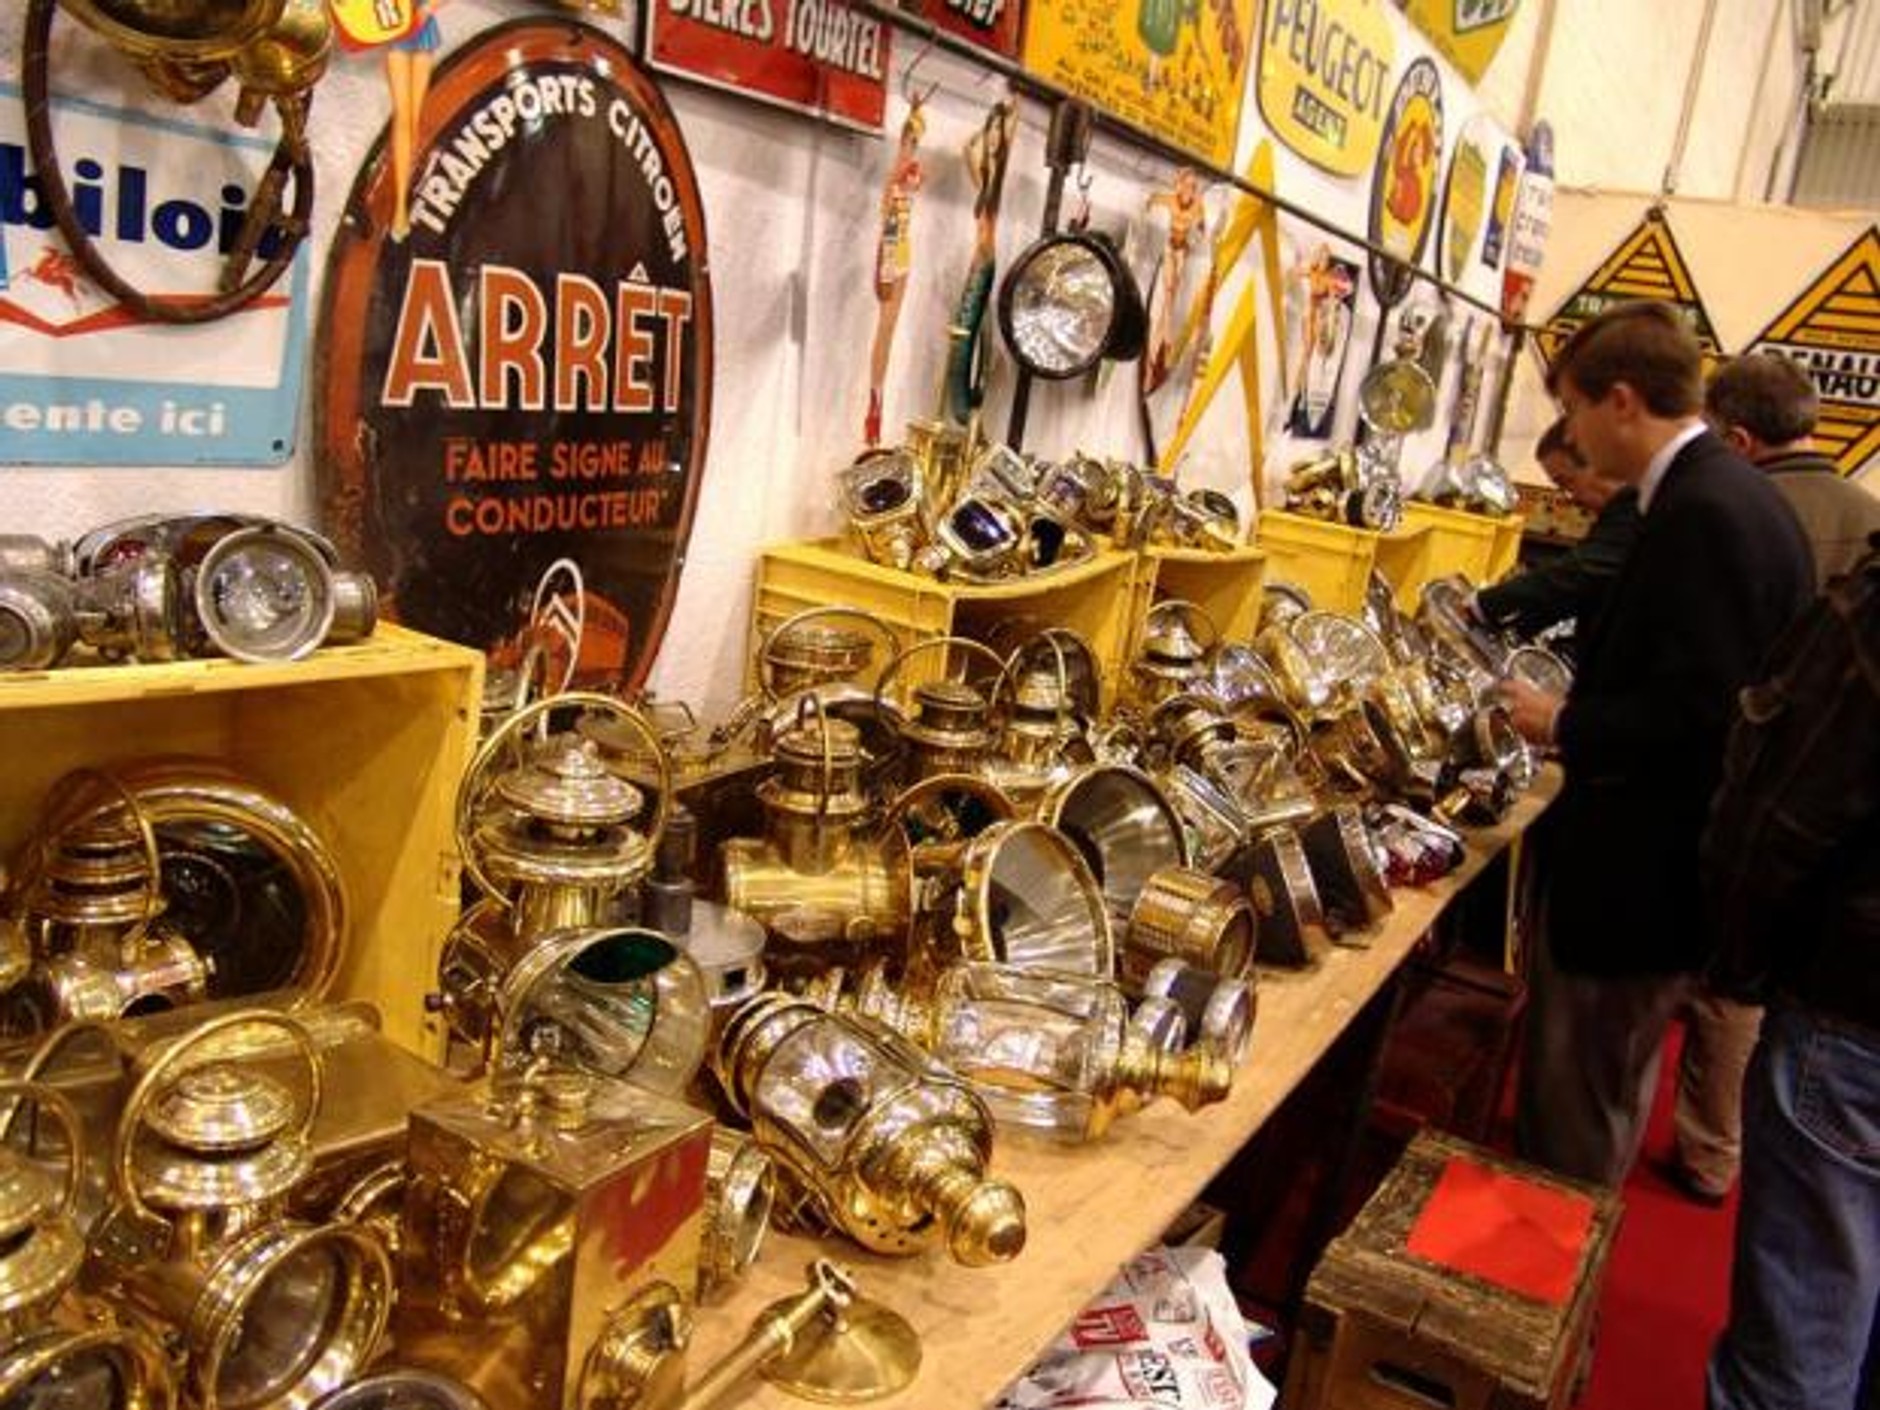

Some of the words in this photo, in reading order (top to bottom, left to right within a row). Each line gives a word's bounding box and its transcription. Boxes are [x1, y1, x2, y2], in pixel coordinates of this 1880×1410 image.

[785, 0, 881, 80] TOURTEL
[1271, 0, 1389, 122] PEUGEOT
[409, 75, 597, 235] TRANSPORTS
[381, 258, 694, 414] ARRÊT
[3, 400, 144, 433] ente
[160, 400, 228, 438] ici
[444, 442, 539, 481] FAIRE
[550, 441, 632, 479] SIGNE
[638, 440, 667, 476] AU
[444, 491, 660, 536] CONDUCTEUR
